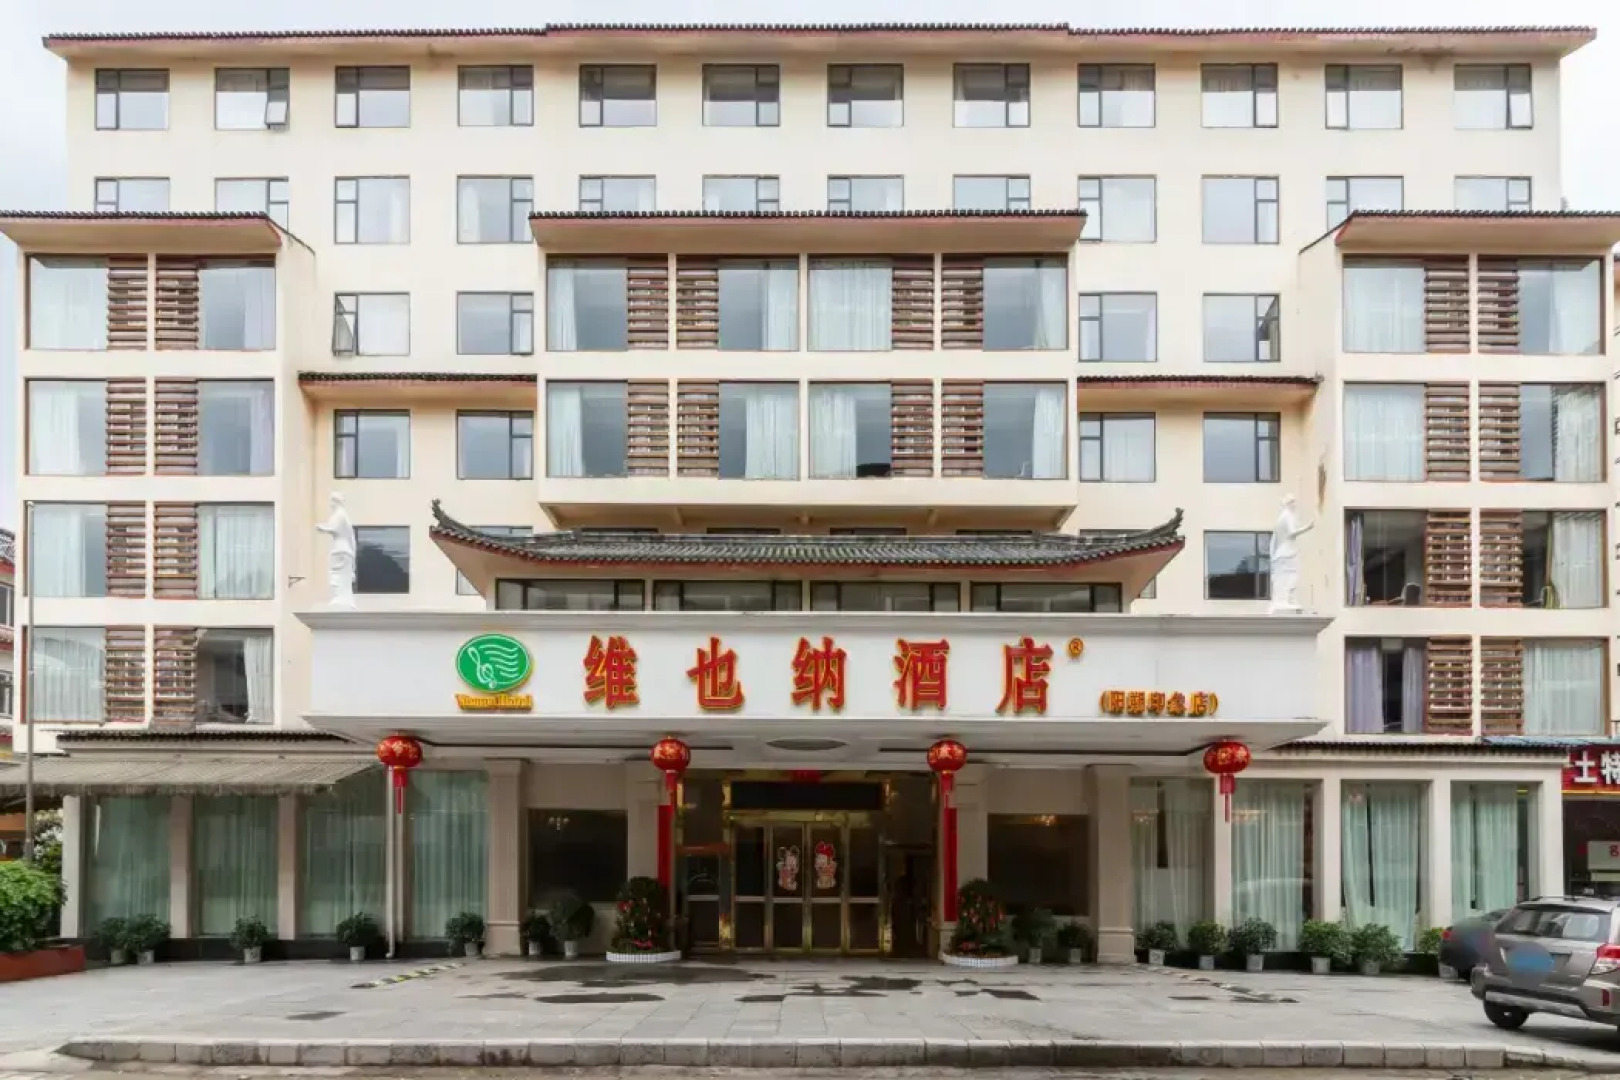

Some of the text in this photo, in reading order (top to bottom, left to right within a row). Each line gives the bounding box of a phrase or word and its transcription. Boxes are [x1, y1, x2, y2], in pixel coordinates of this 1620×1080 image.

[583, 635, 1053, 714] 维也纳酒店
